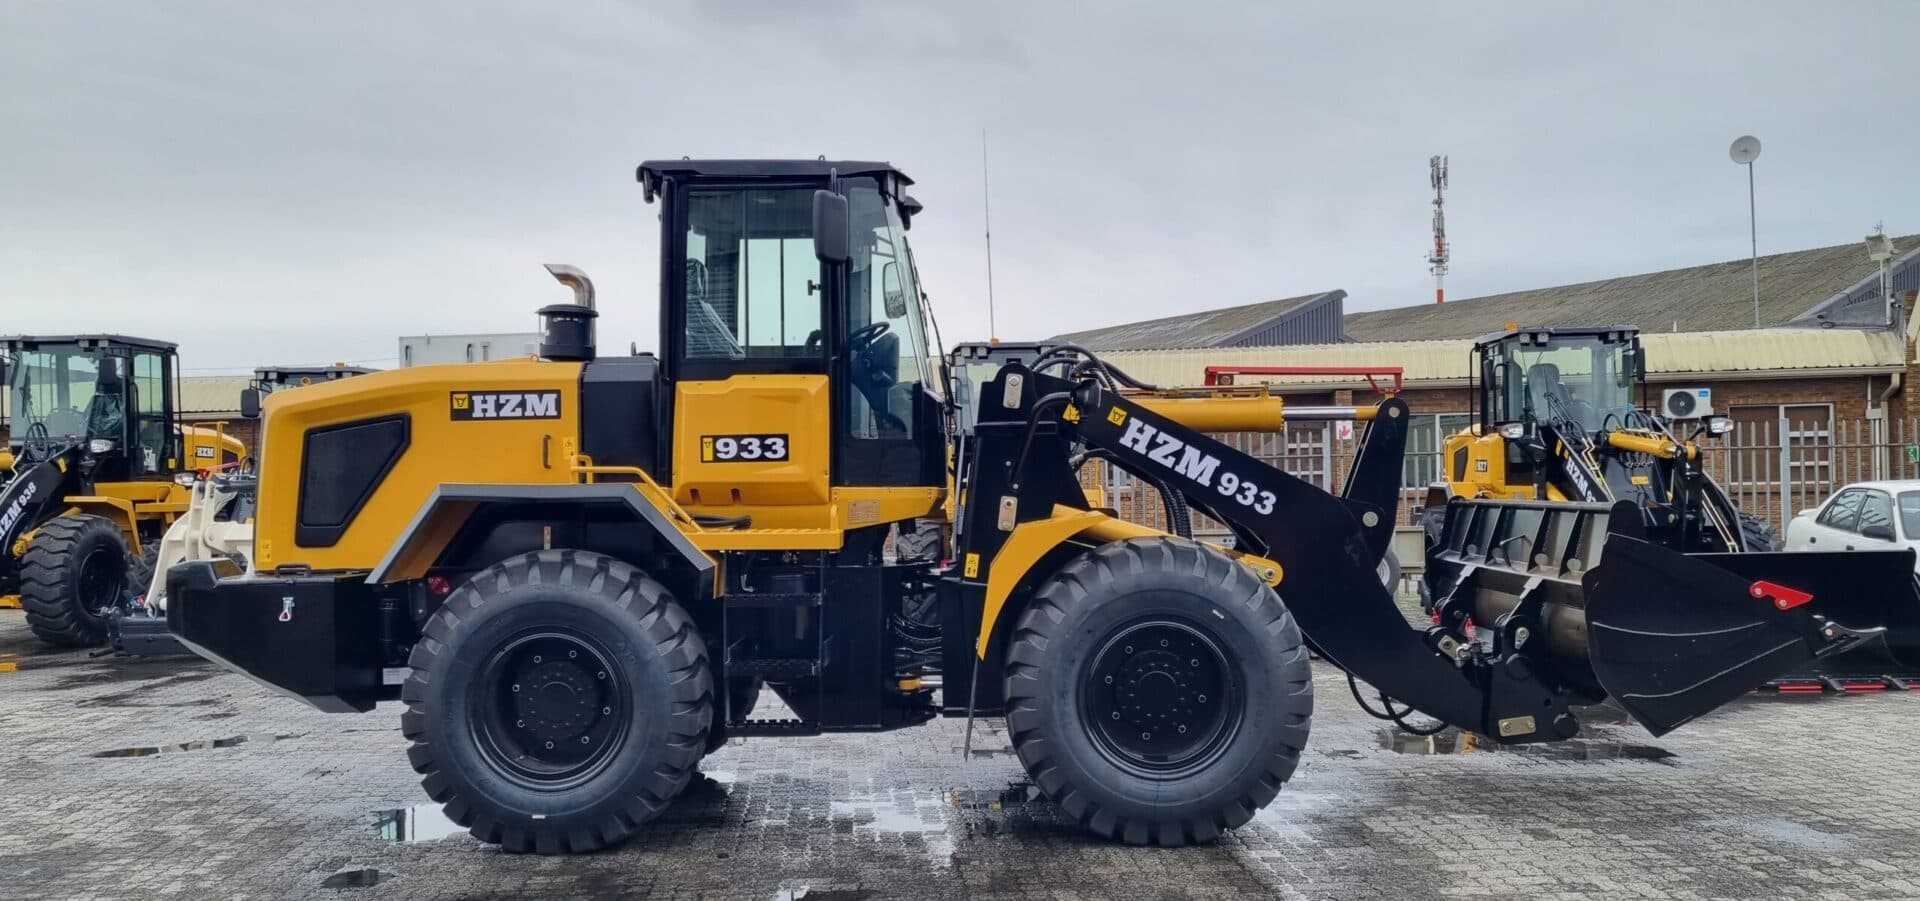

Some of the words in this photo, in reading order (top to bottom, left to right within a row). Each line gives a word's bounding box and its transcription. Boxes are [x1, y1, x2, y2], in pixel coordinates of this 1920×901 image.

[471, 393, 558, 418] HZM
[715, 437, 786, 459] 933
[1119, 416, 1221, 487] HZM
[1217, 472, 1277, 515] 933
[1566, 456, 1588, 497] HZM
[19, 481, 37, 507] 938
